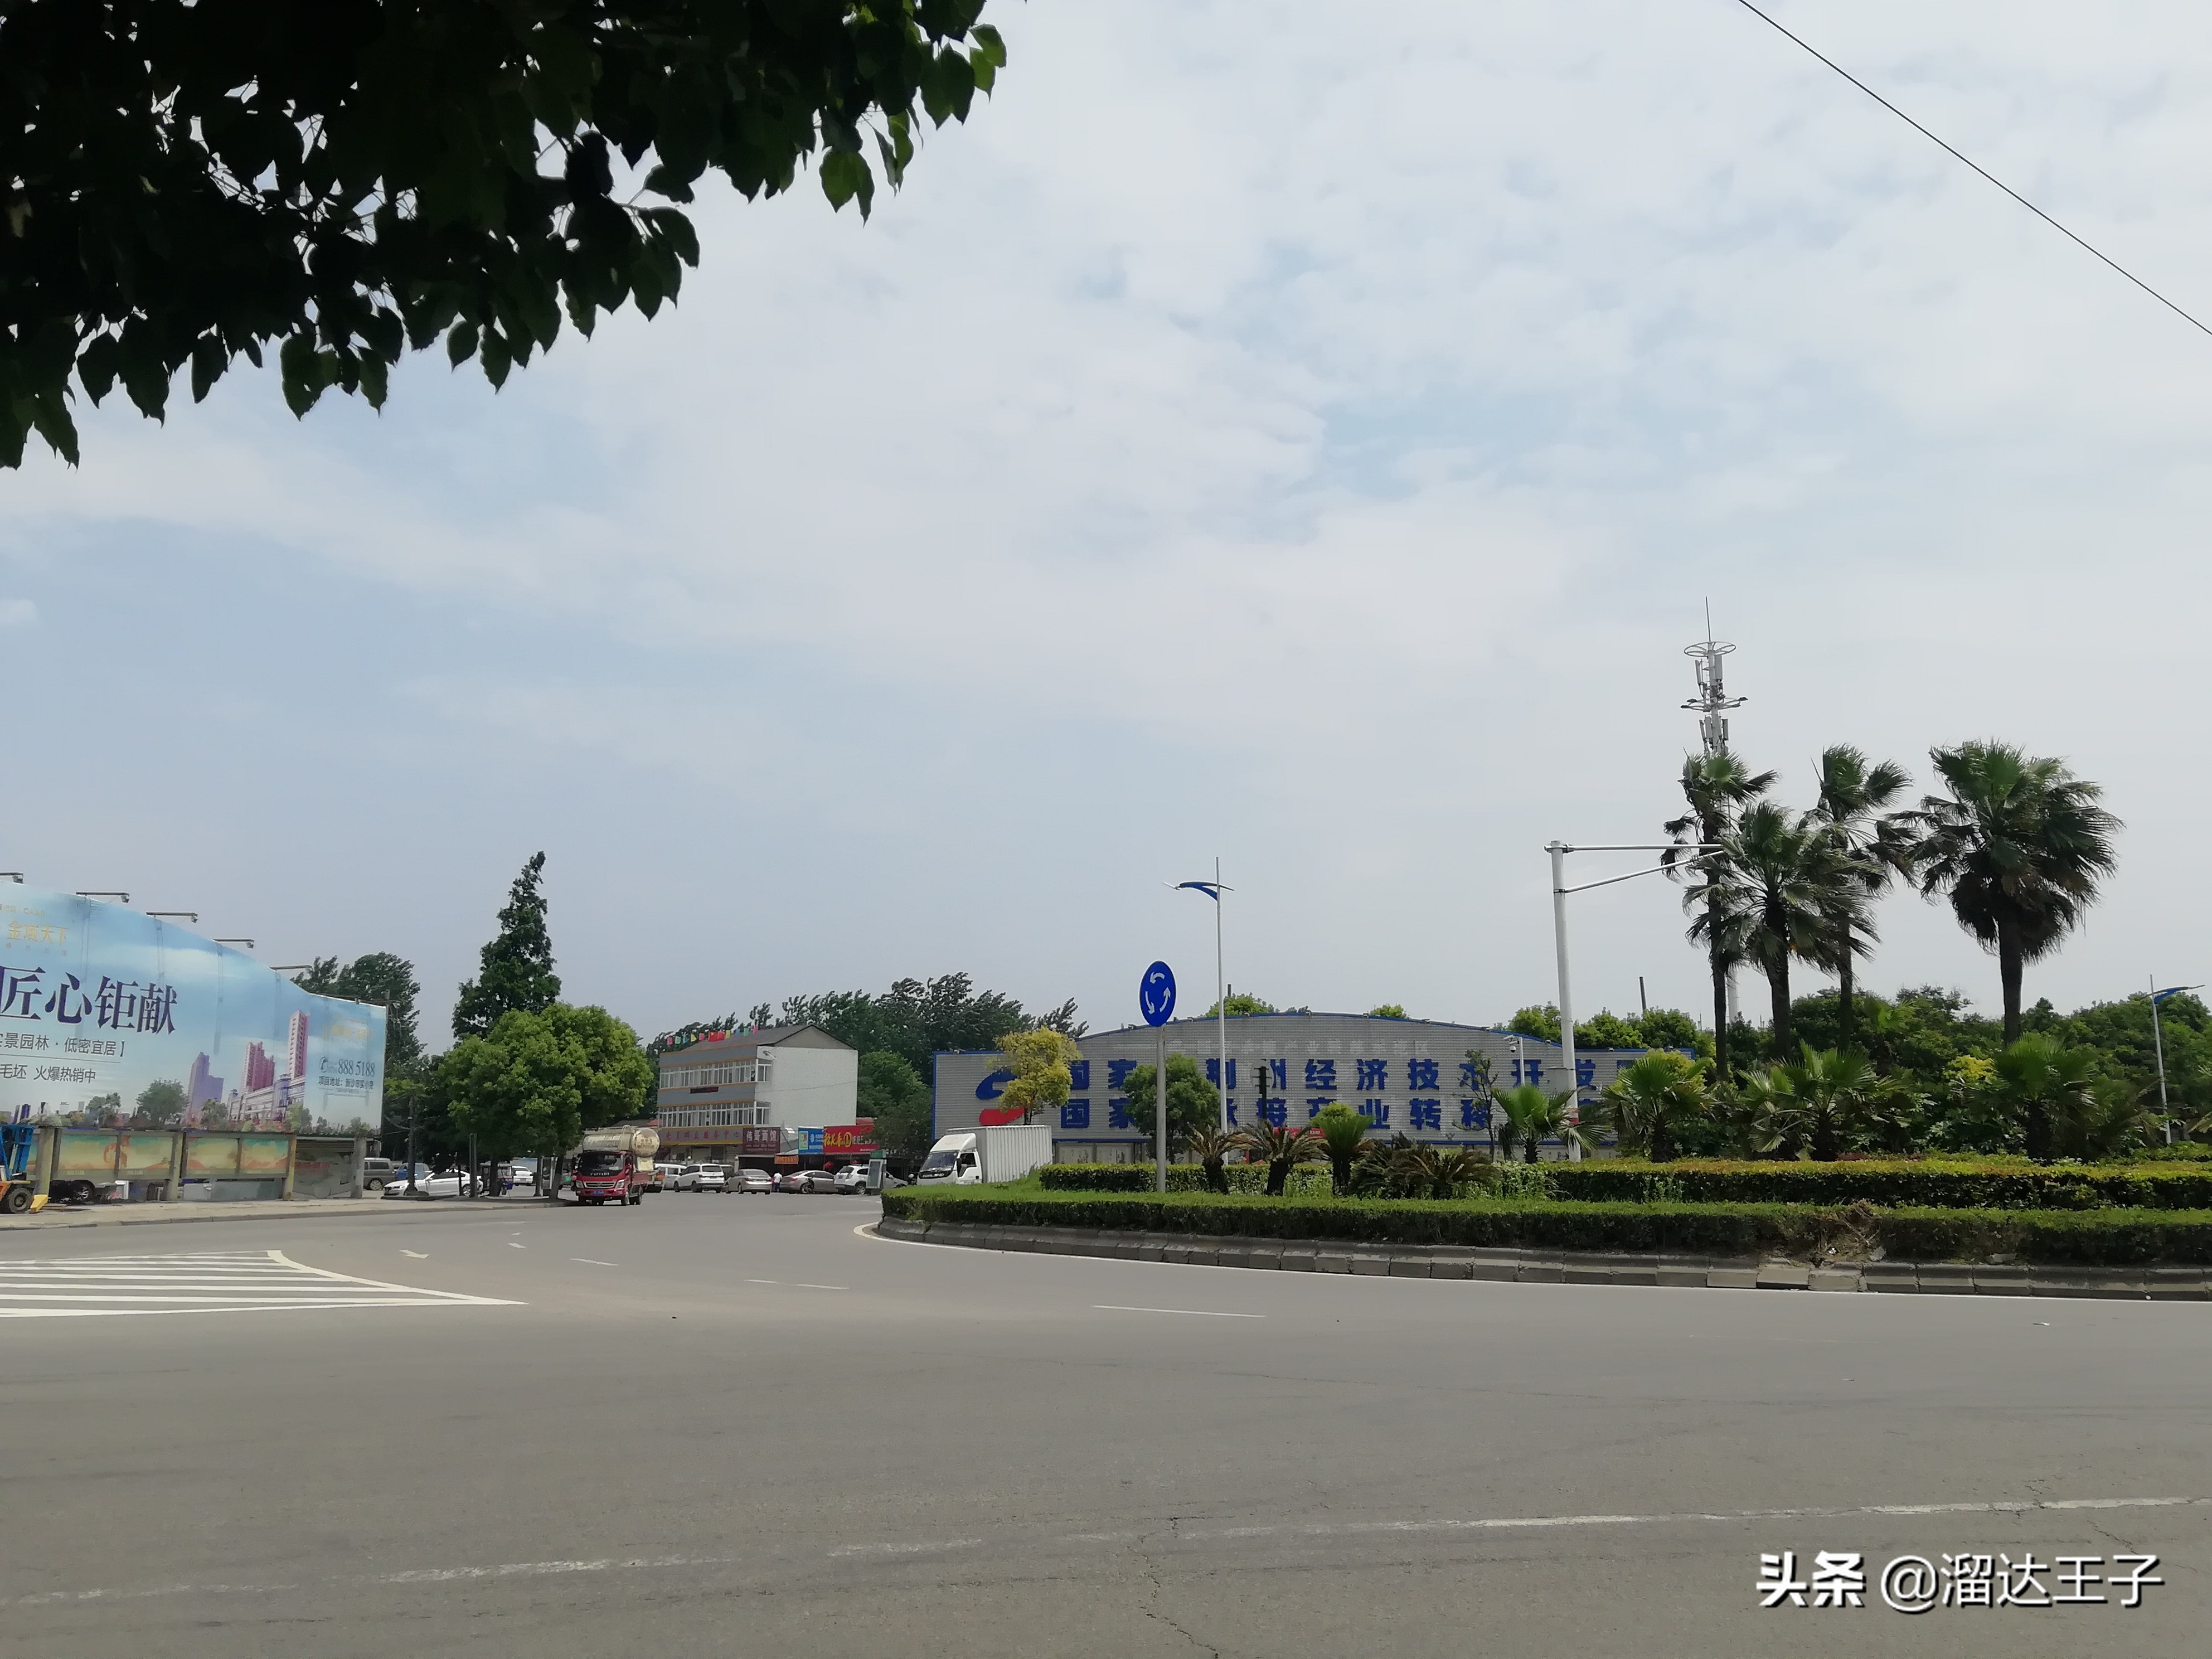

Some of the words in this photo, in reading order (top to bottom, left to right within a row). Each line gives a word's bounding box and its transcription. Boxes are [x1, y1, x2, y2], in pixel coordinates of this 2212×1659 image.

[0, 966, 178, 1035] 匠心钜献
[0, 1032, 125, 1058] 景园林·低密宜居】
[33, 1065, 96, 1084] 火爆热销中
[338, 1059, 354, 1075] 888
